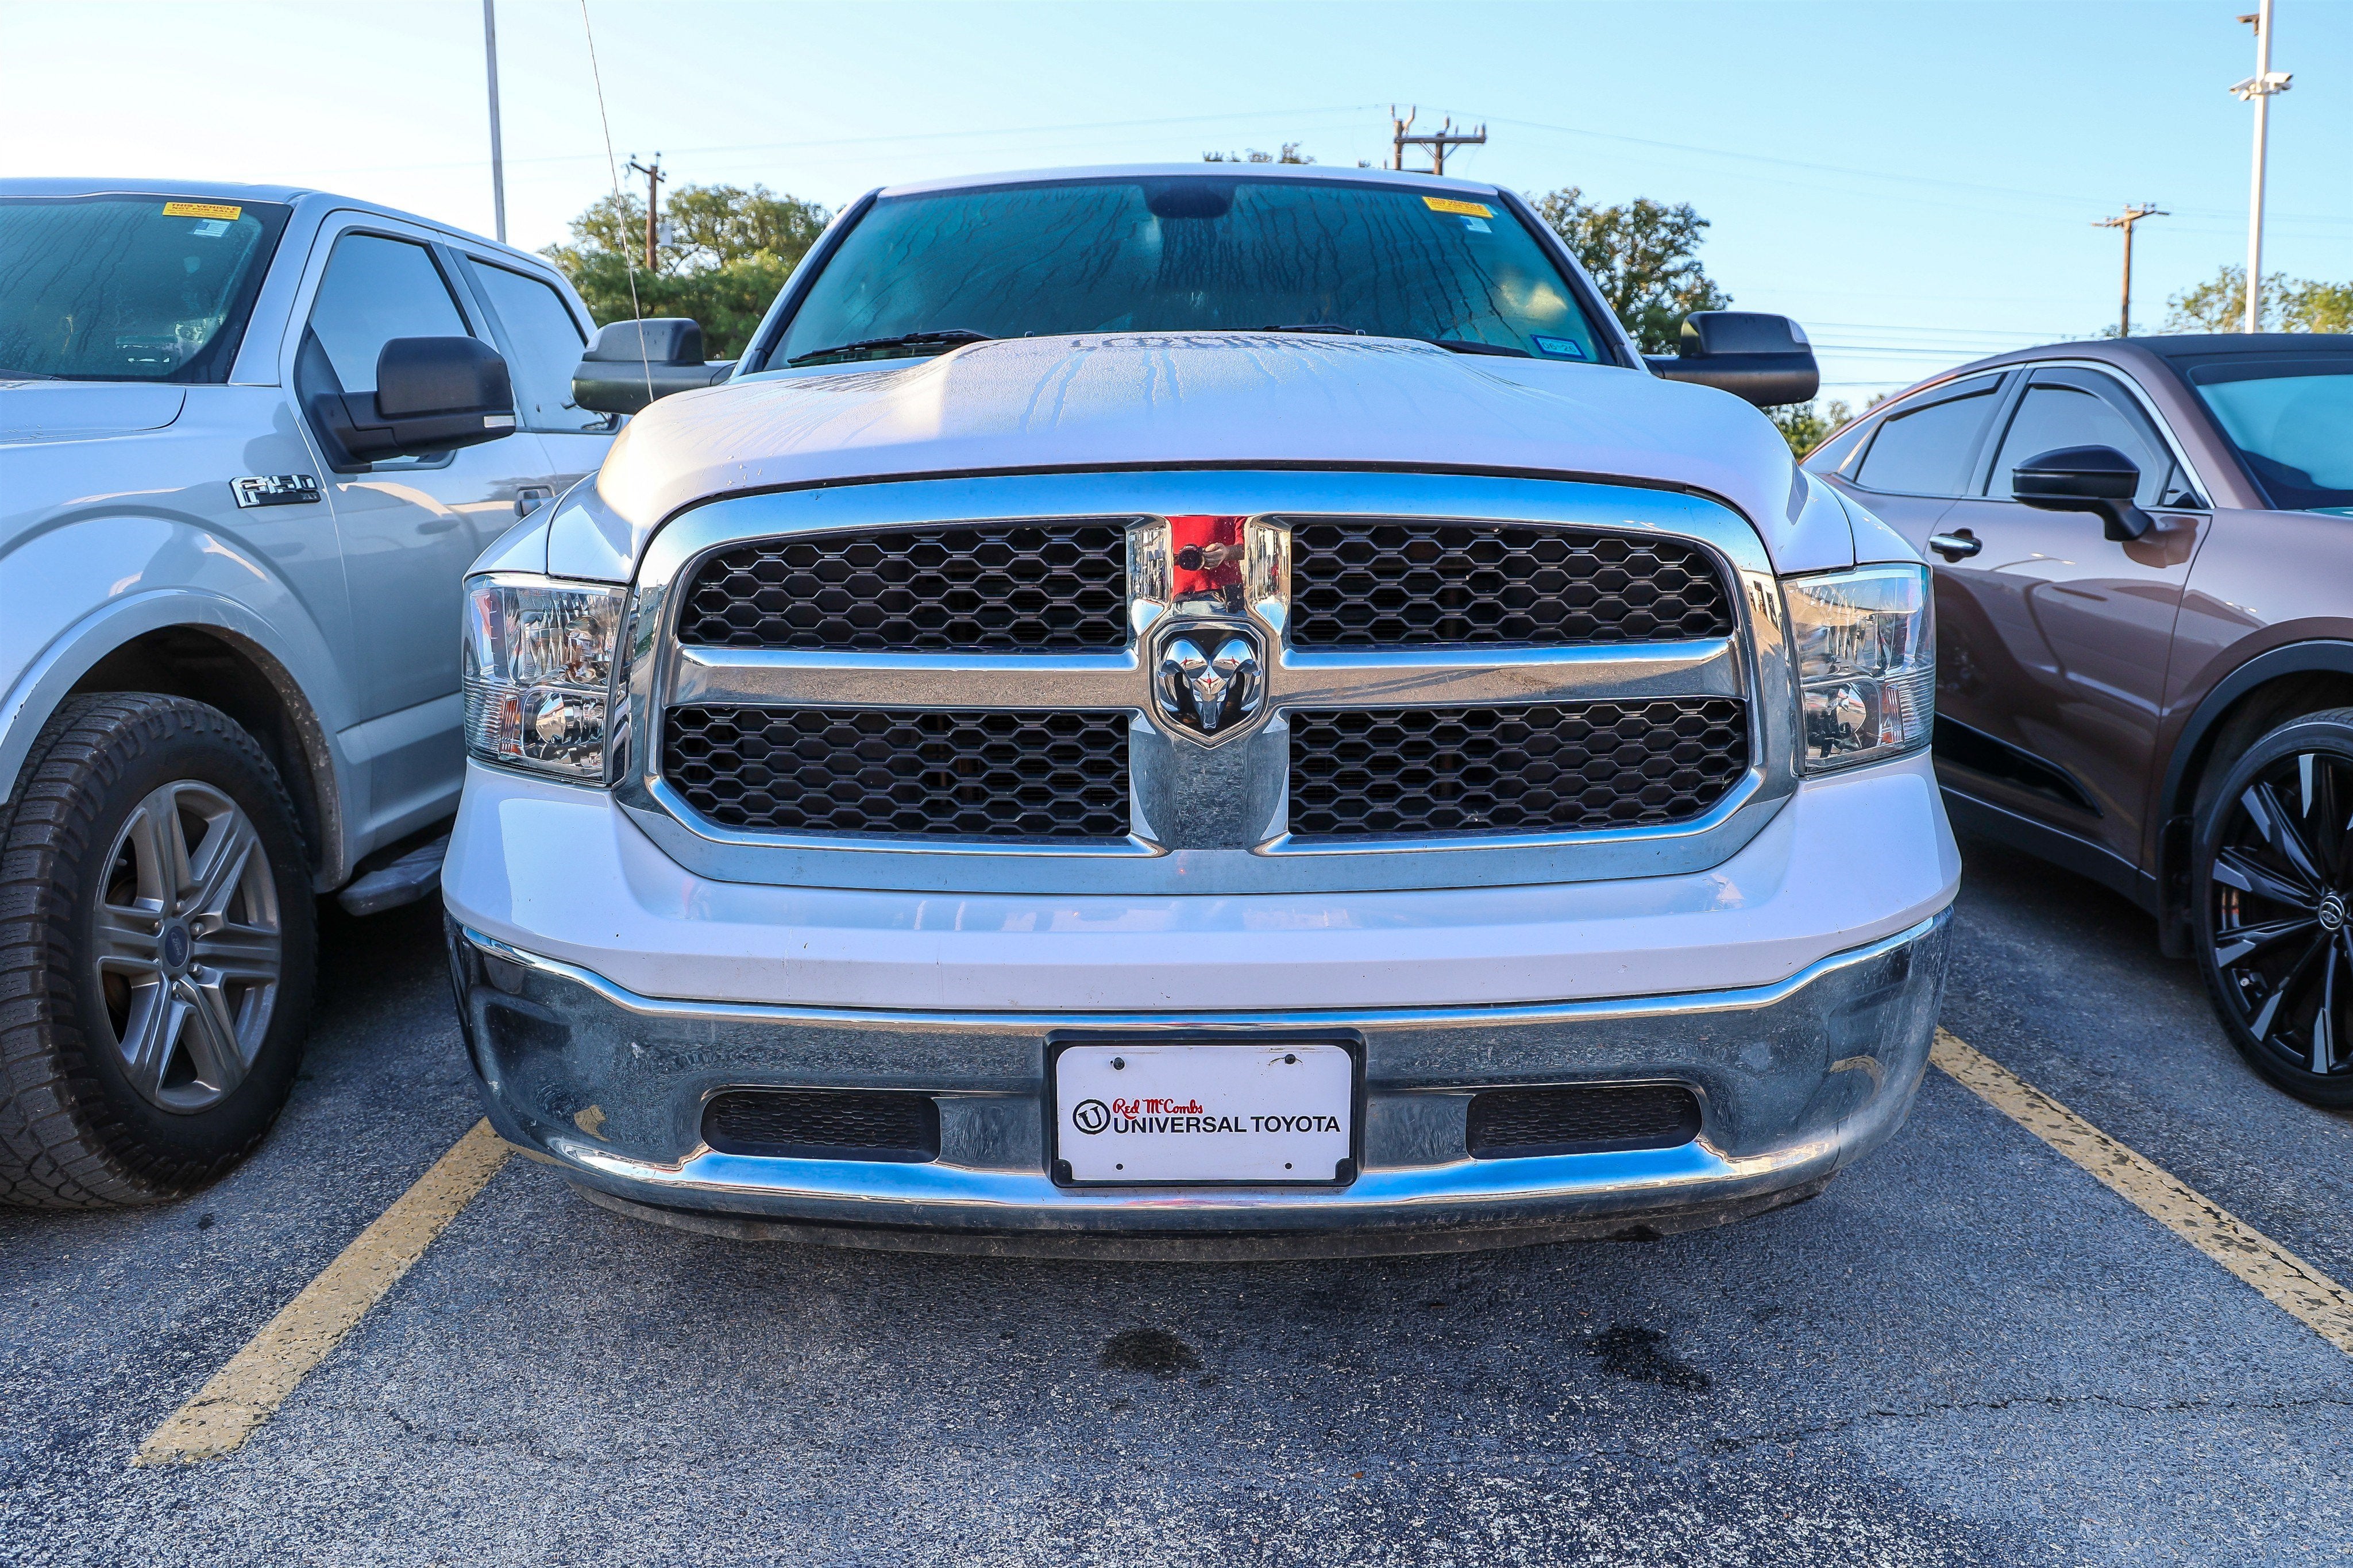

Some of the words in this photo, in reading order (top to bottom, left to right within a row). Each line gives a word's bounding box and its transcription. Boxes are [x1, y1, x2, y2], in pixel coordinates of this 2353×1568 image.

[1113, 1098, 1140, 1120] Red
[1143, 1099, 1203, 1114] McCombs
[1114, 1116, 1247, 1133] UNIVERSAL
[1250, 1116, 1341, 1133] TOYOTA
